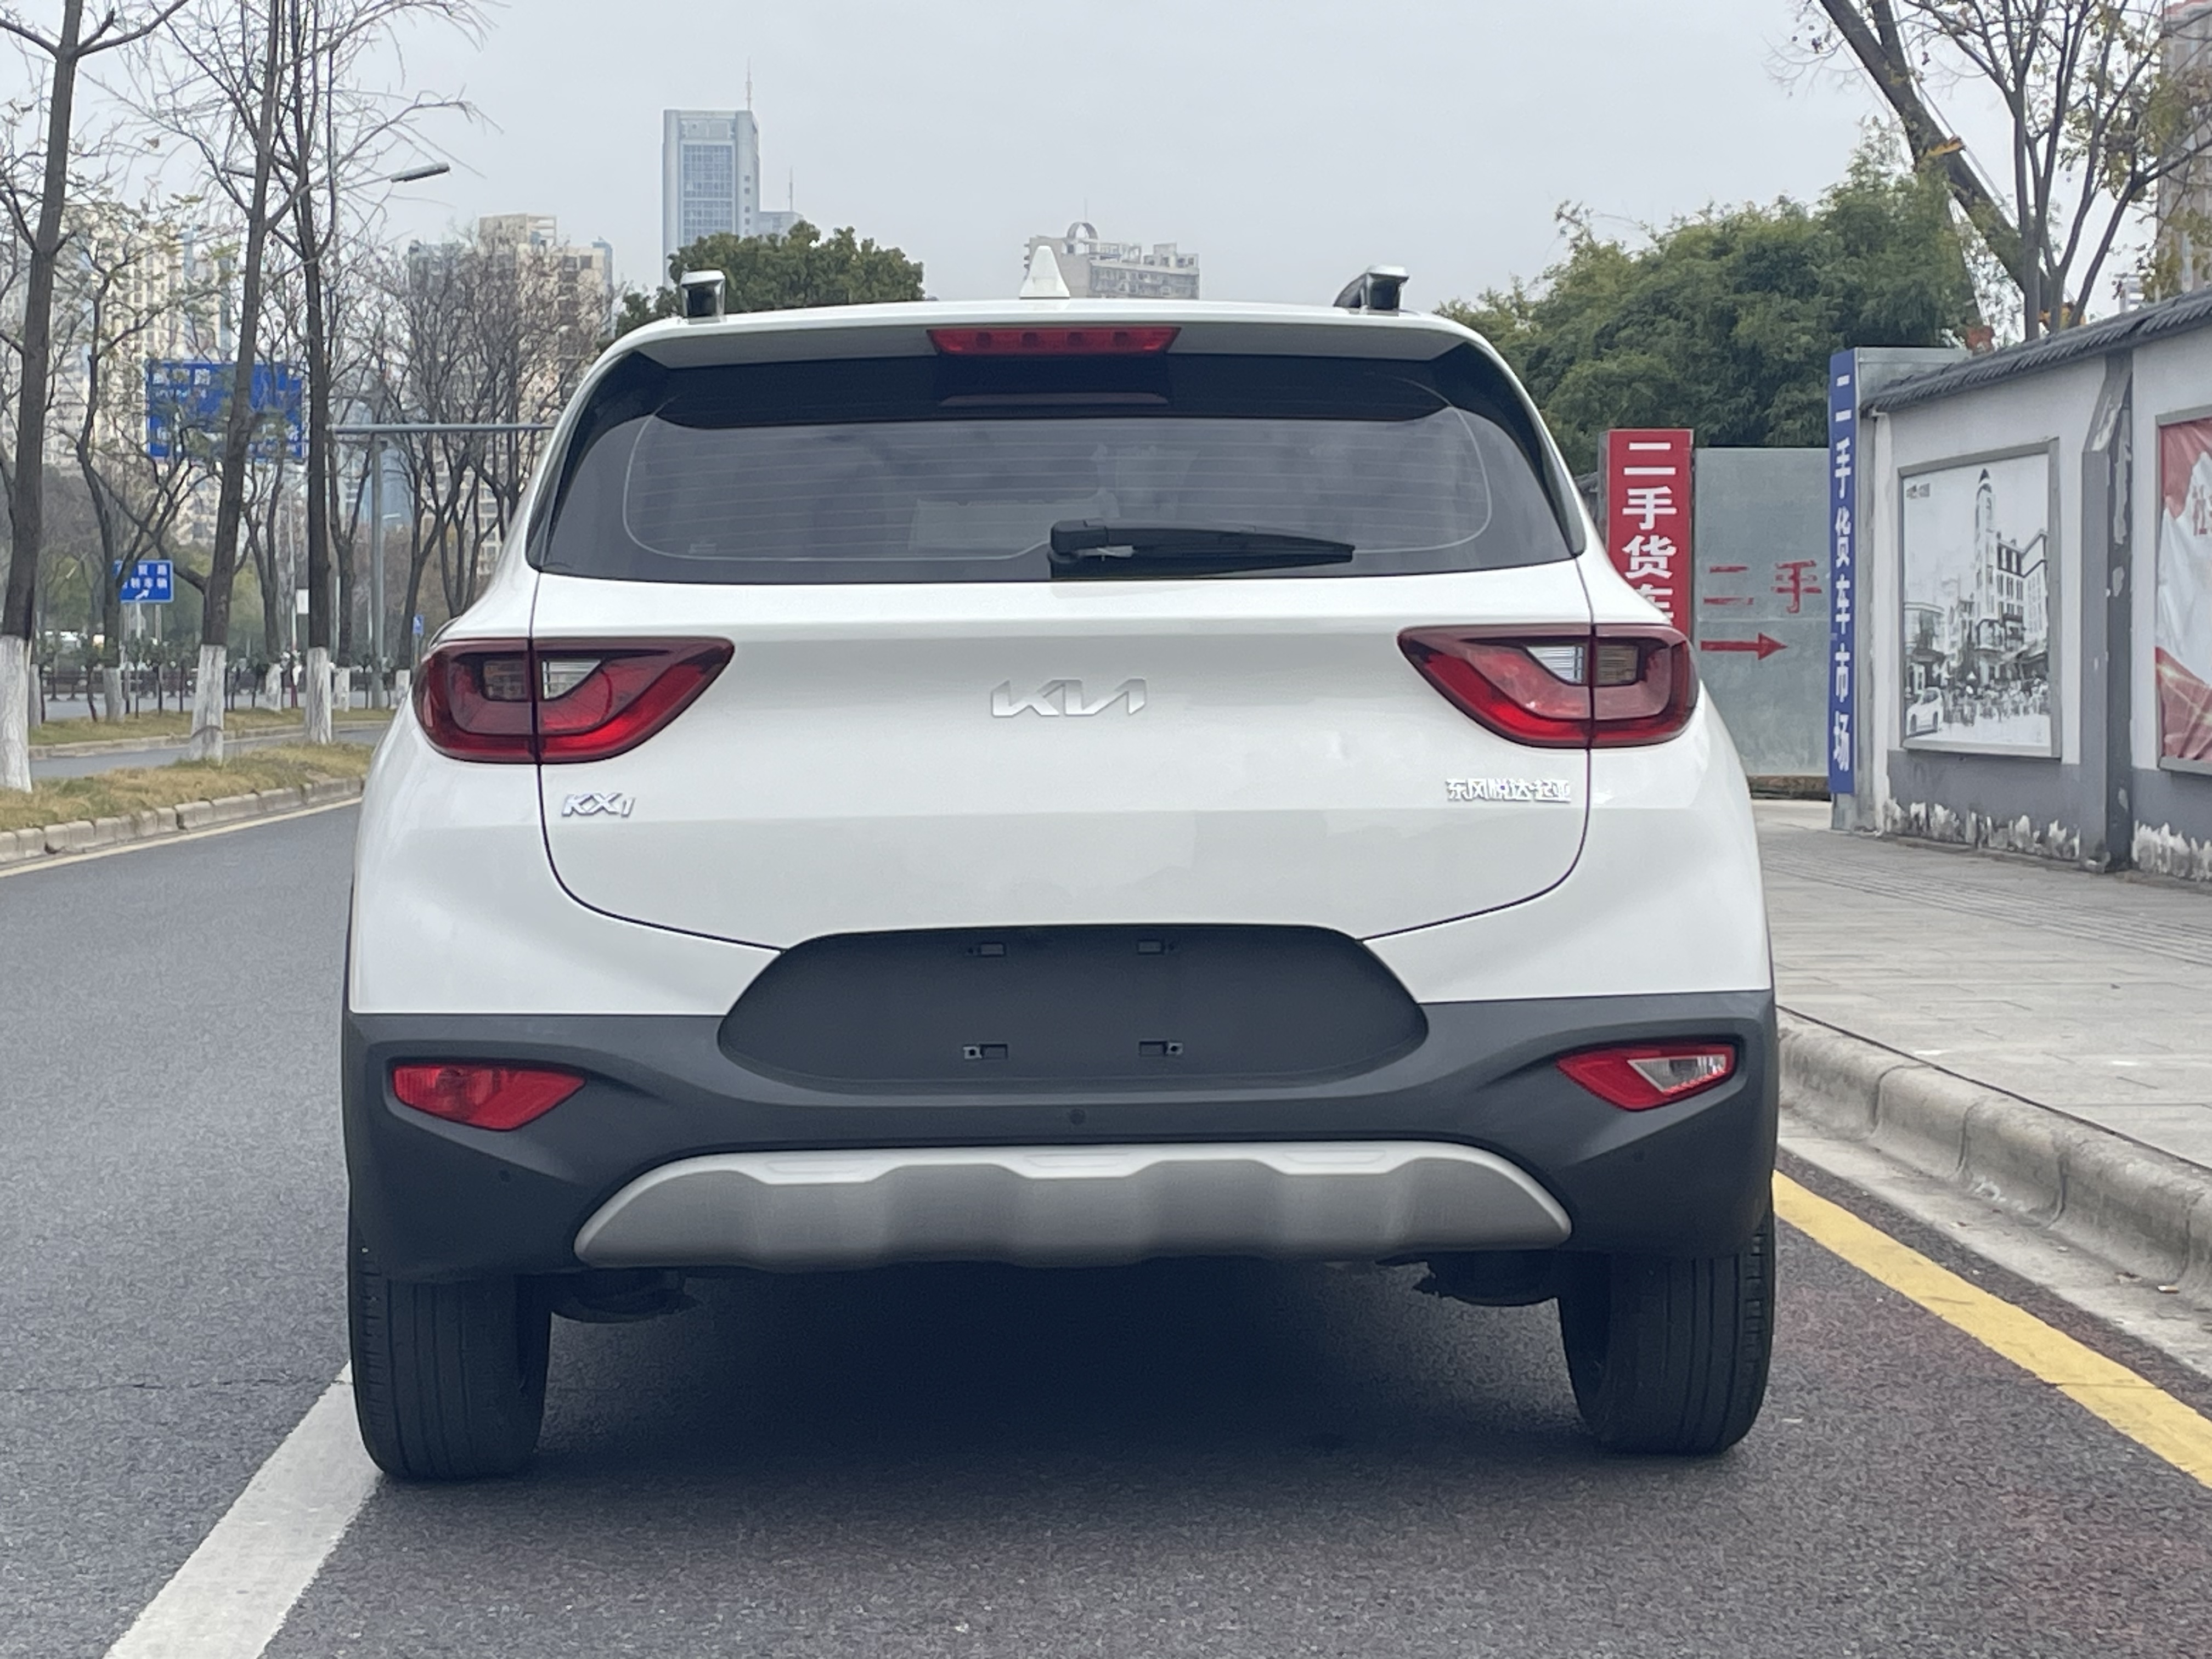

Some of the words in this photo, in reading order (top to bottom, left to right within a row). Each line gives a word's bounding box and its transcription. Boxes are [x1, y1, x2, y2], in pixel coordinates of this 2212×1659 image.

[1833, 374, 1852, 772] 二手货车市场
[990, 678, 1147, 718] KIA
[561, 792, 636, 819] KX1
